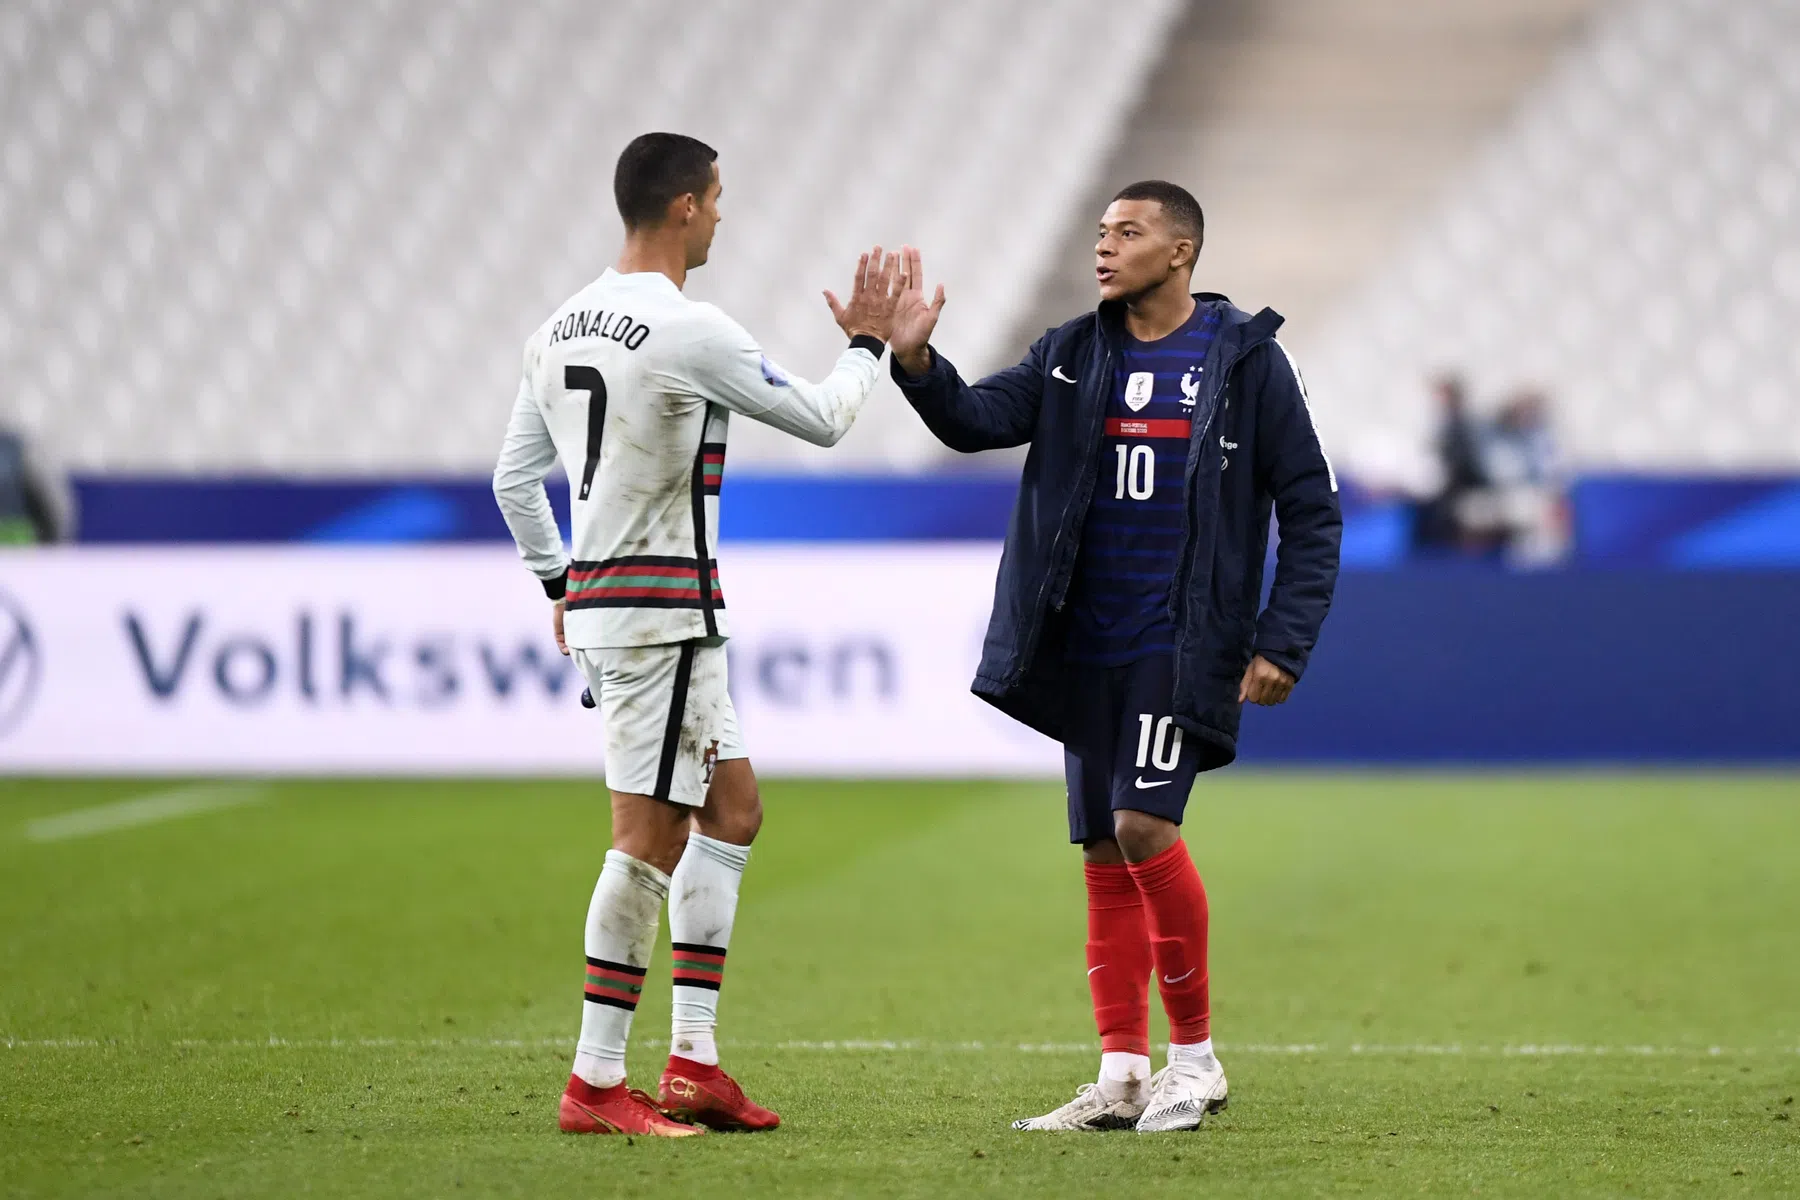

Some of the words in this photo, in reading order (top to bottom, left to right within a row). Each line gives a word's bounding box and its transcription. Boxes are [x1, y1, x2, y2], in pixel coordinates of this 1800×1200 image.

[549, 310, 650, 351] RONALDO
[564, 365, 608, 501] 7
[1115, 444, 1155, 501] 10
[120, 604, 895, 708] Volkswen
[1135, 713, 1184, 772] 10
[670, 1077, 697, 1101] CR
